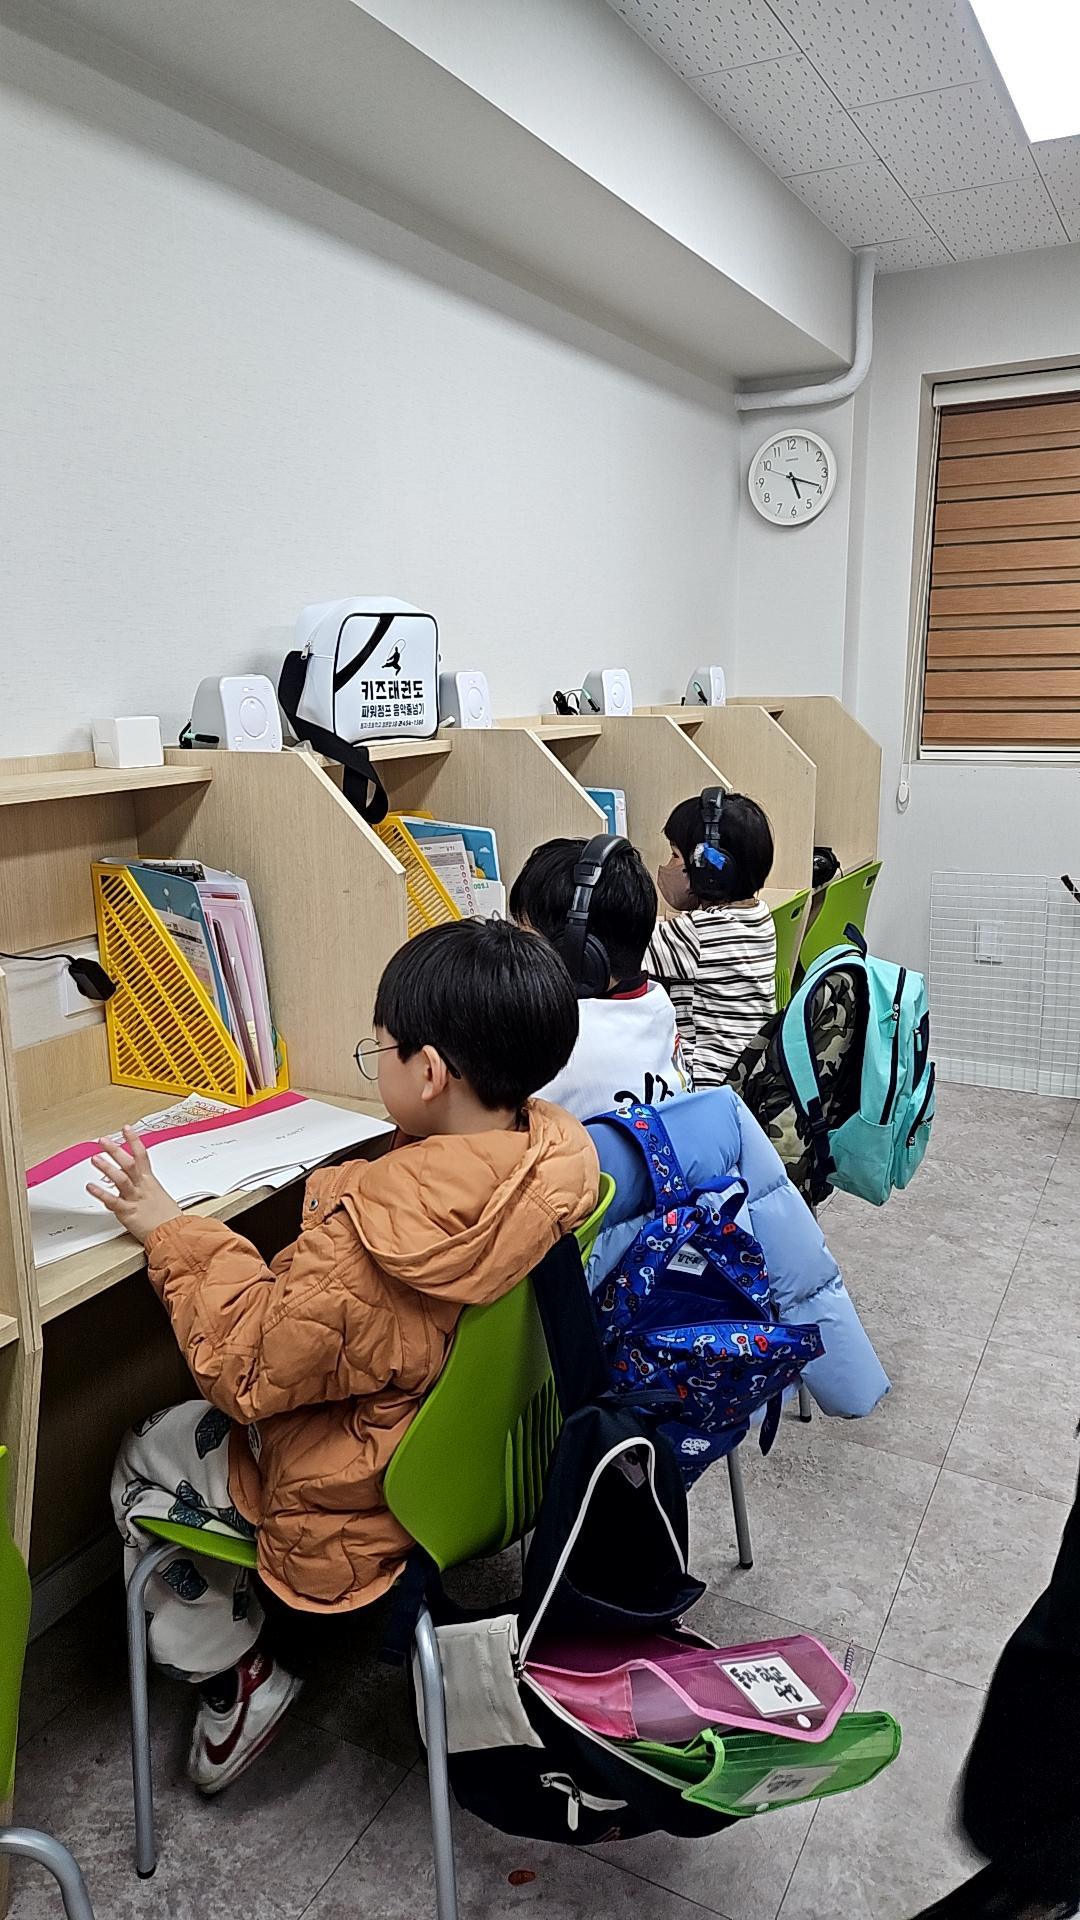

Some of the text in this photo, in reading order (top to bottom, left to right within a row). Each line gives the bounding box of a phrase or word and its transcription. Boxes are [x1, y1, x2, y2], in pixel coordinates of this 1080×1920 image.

[786, 438, 797, 451] 12
[805, 440, 809, 452] 1
[773, 446, 781, 458] 11
[815, 451, 823, 462] 2
[763, 460, 772, 471] 10
[821, 467, 828, 478] 3
[758, 477, 765, 488] 9
[816, 485, 823, 495] 4
[763, 492, 771, 503] 8
[776, 502, 783, 514] 7
[805, 498, 813, 510] 5
[790, 505, 797, 516] 6
[360, 680, 424, 700] 키즈태권도
[361, 702, 425, 718] 파워점프 음악줄넘기
